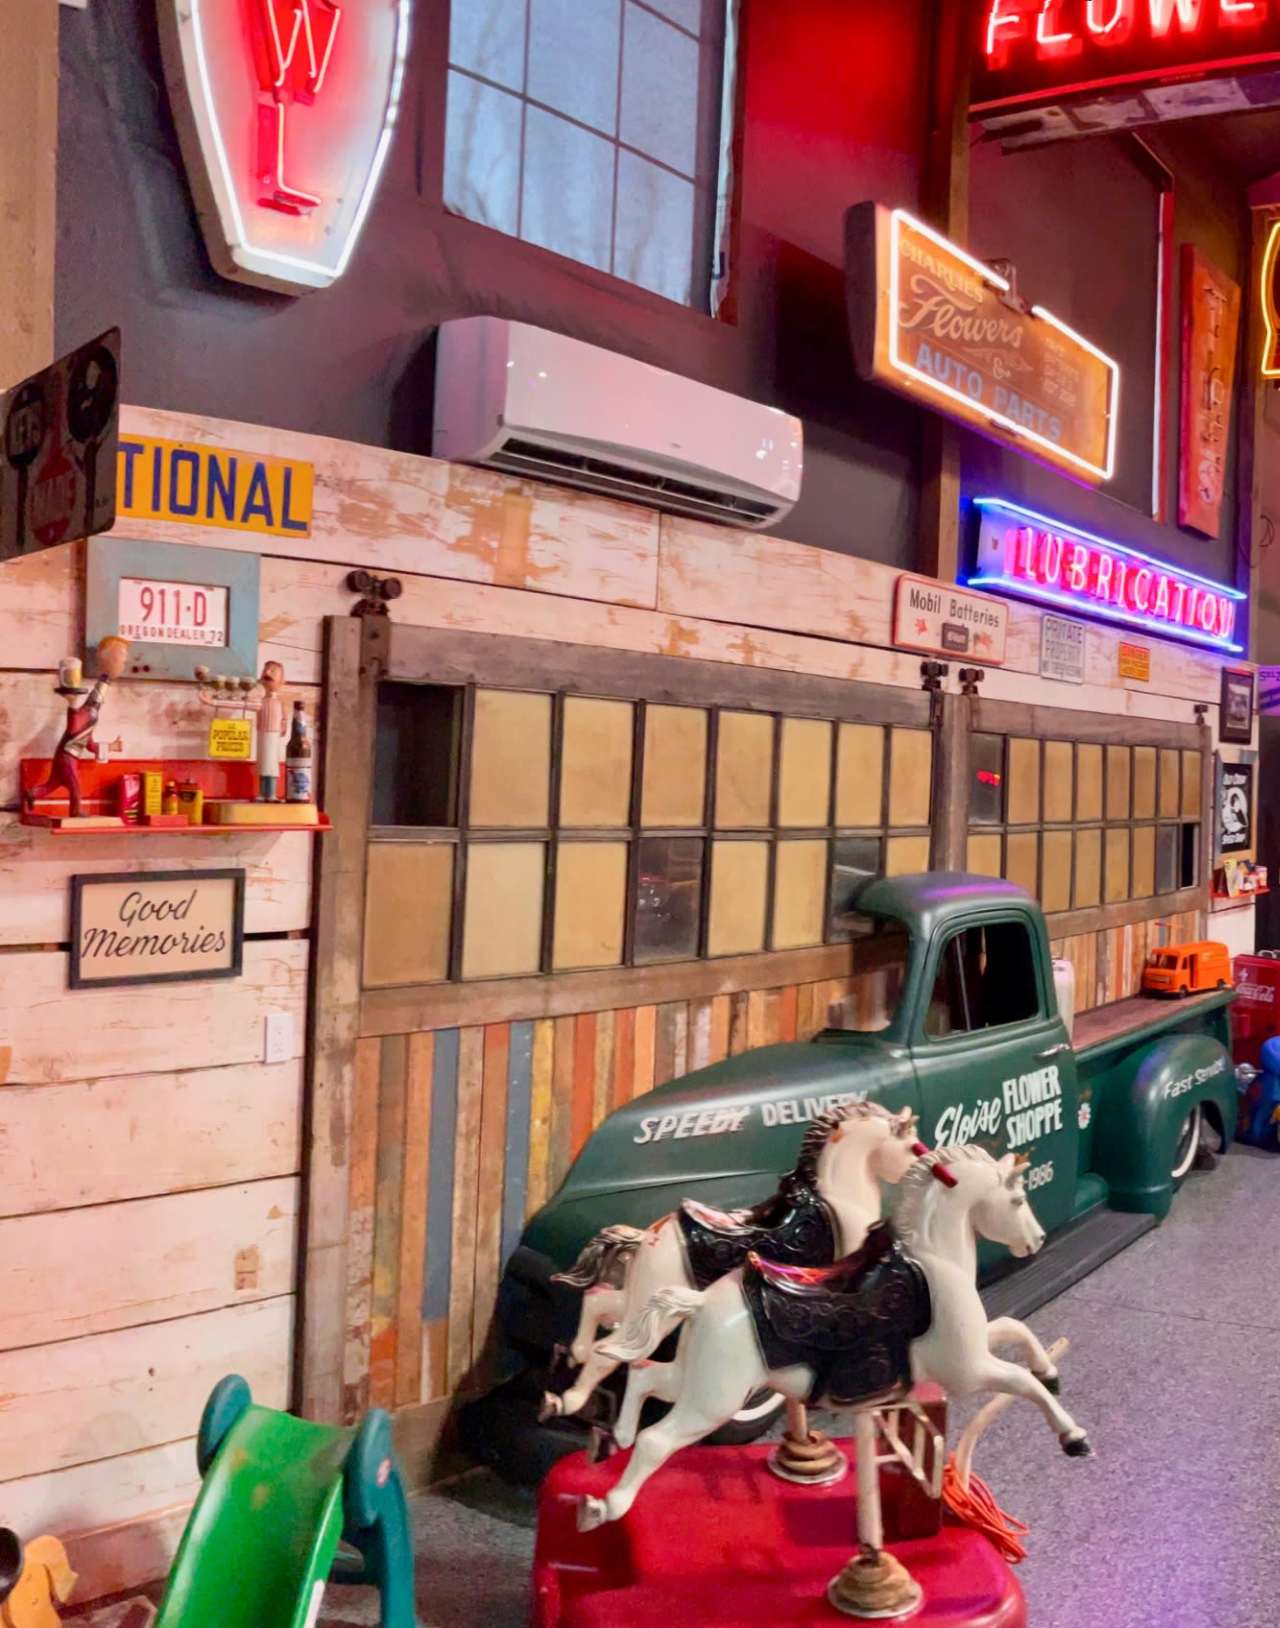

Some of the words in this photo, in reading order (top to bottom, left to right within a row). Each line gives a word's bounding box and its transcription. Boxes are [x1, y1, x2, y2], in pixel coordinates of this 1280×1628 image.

[898, 274, 1024, 349] Flowers
[916, 343, 984, 402] AUTO
[994, 385, 1063, 442] PARTS
[117, 441, 307, 531] TIONAL
[1005, 526, 1236, 640] LUBRICATION
[910, 588, 942, 614] Mobil
[950, 599, 999, 628] Batteries
[120, 623, 165, 638] OREGON
[167, 626, 206, 640] DEALER
[119, 887, 197, 923] Good
[81, 926, 226, 959] Memories
[1002, 1065, 1062, 1112] FLOWER
[1164, 1075, 1193, 1100] Fast
[633, 1106, 749, 1145] SPEEDY
[935, 1096, 1001, 1148] Eloise
[1006, 1099, 1063, 1150] SHOPPE
